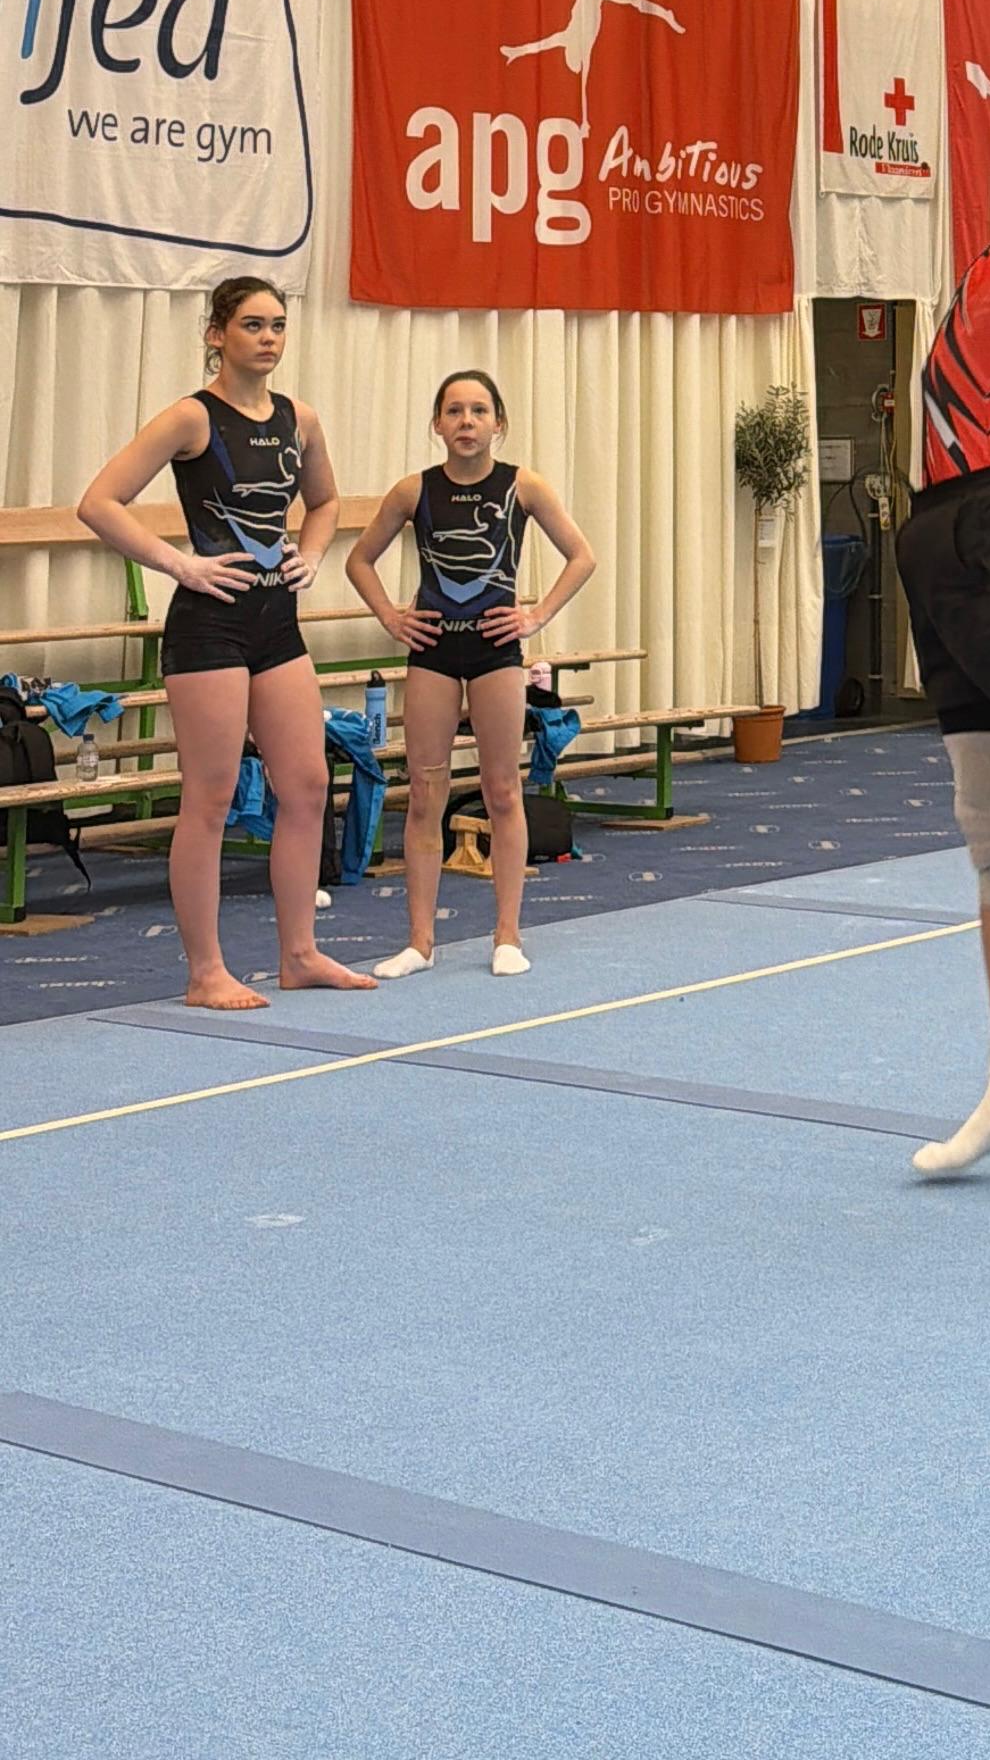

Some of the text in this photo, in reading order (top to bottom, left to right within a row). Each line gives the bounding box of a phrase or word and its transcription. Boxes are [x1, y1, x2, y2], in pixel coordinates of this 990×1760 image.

[67, 108, 272, 164] we are gym
[849, 123, 919, 164] Rode Kruis
[405, 106, 592, 246] apg
[608, 186, 765, 222] PRO GYMNASTICS
[249, 436, 281, 447] HALO
[451, 493, 483, 502] HALO
